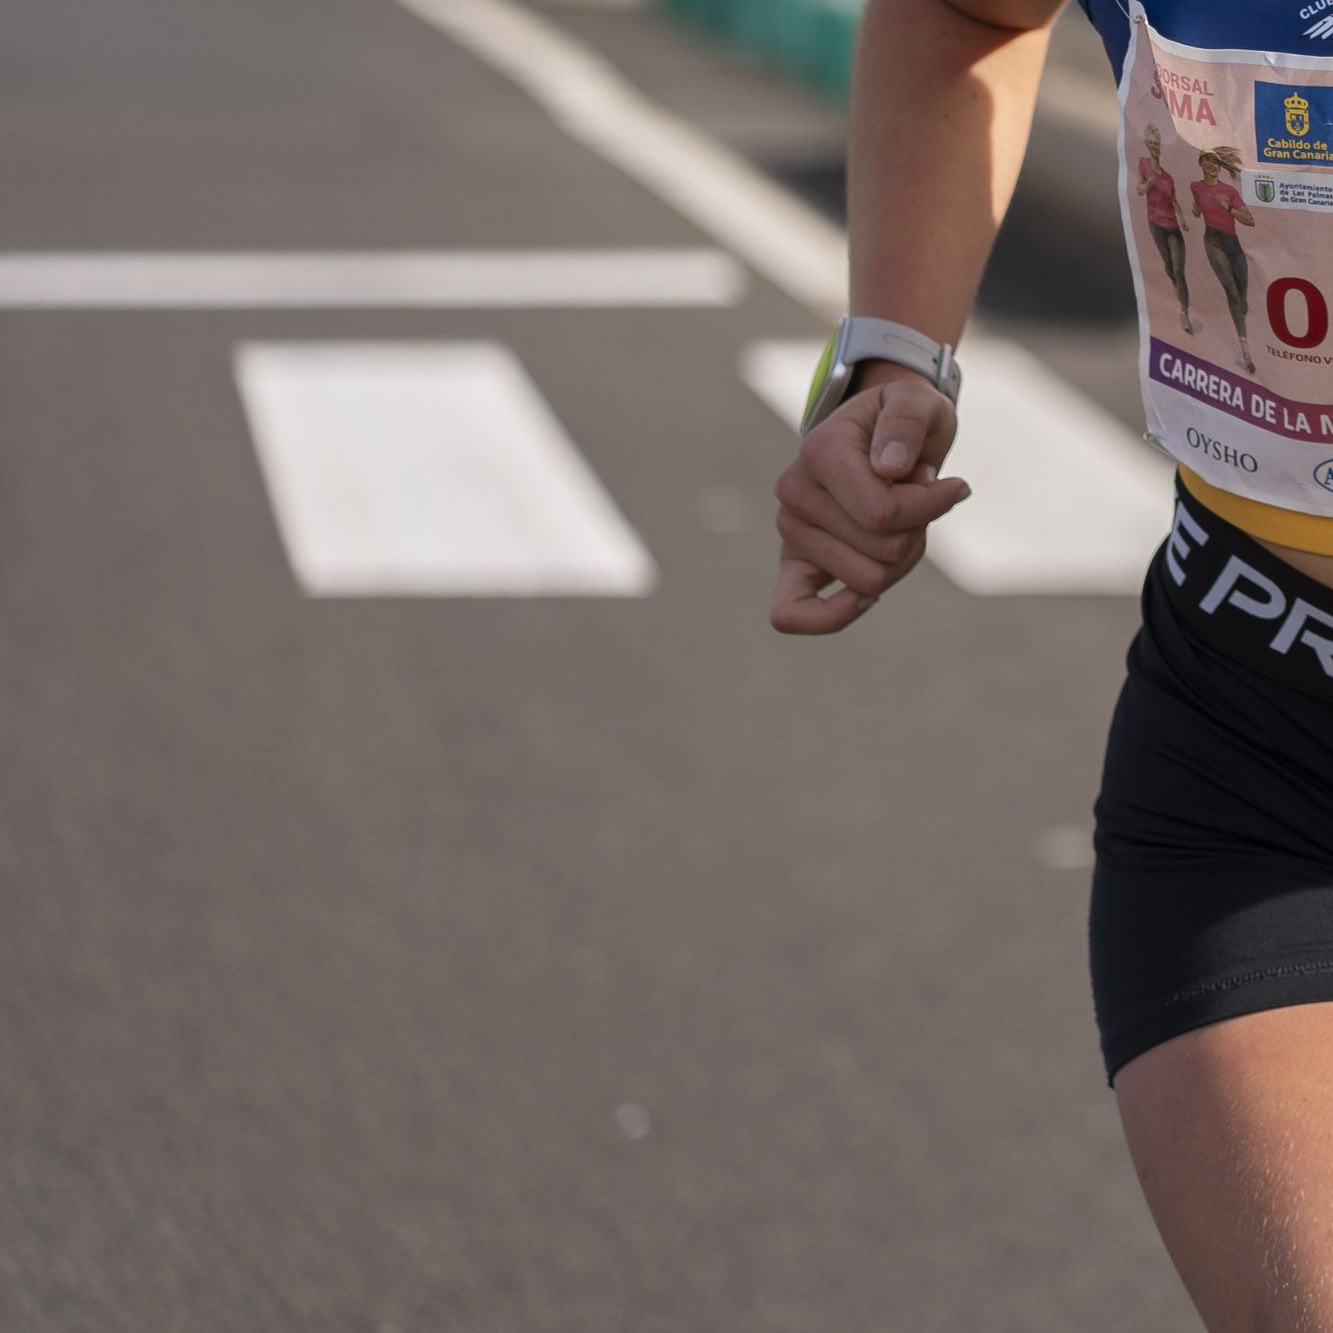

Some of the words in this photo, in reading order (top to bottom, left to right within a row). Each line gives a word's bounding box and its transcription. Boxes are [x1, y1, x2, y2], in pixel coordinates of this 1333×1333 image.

[1267, 138, 1310, 150] Cabildo
[1313, 140, 1328, 150] de
[1263, 148, 1290, 158] Gran
[1280, 183, 1332, 192] Ayuntamiento
[1290, 196, 1306, 204] Gran
[1308, 198, 1333, 206] Canaria
[1265, 345, 1321, 364] TELÉFONO
[1159, 353, 1245, 411] CARRERA
[1251, 396, 1277, 424] DE
[1283, 407, 1312, 434] LA
[1186, 426, 1258, 473] OYSHO
